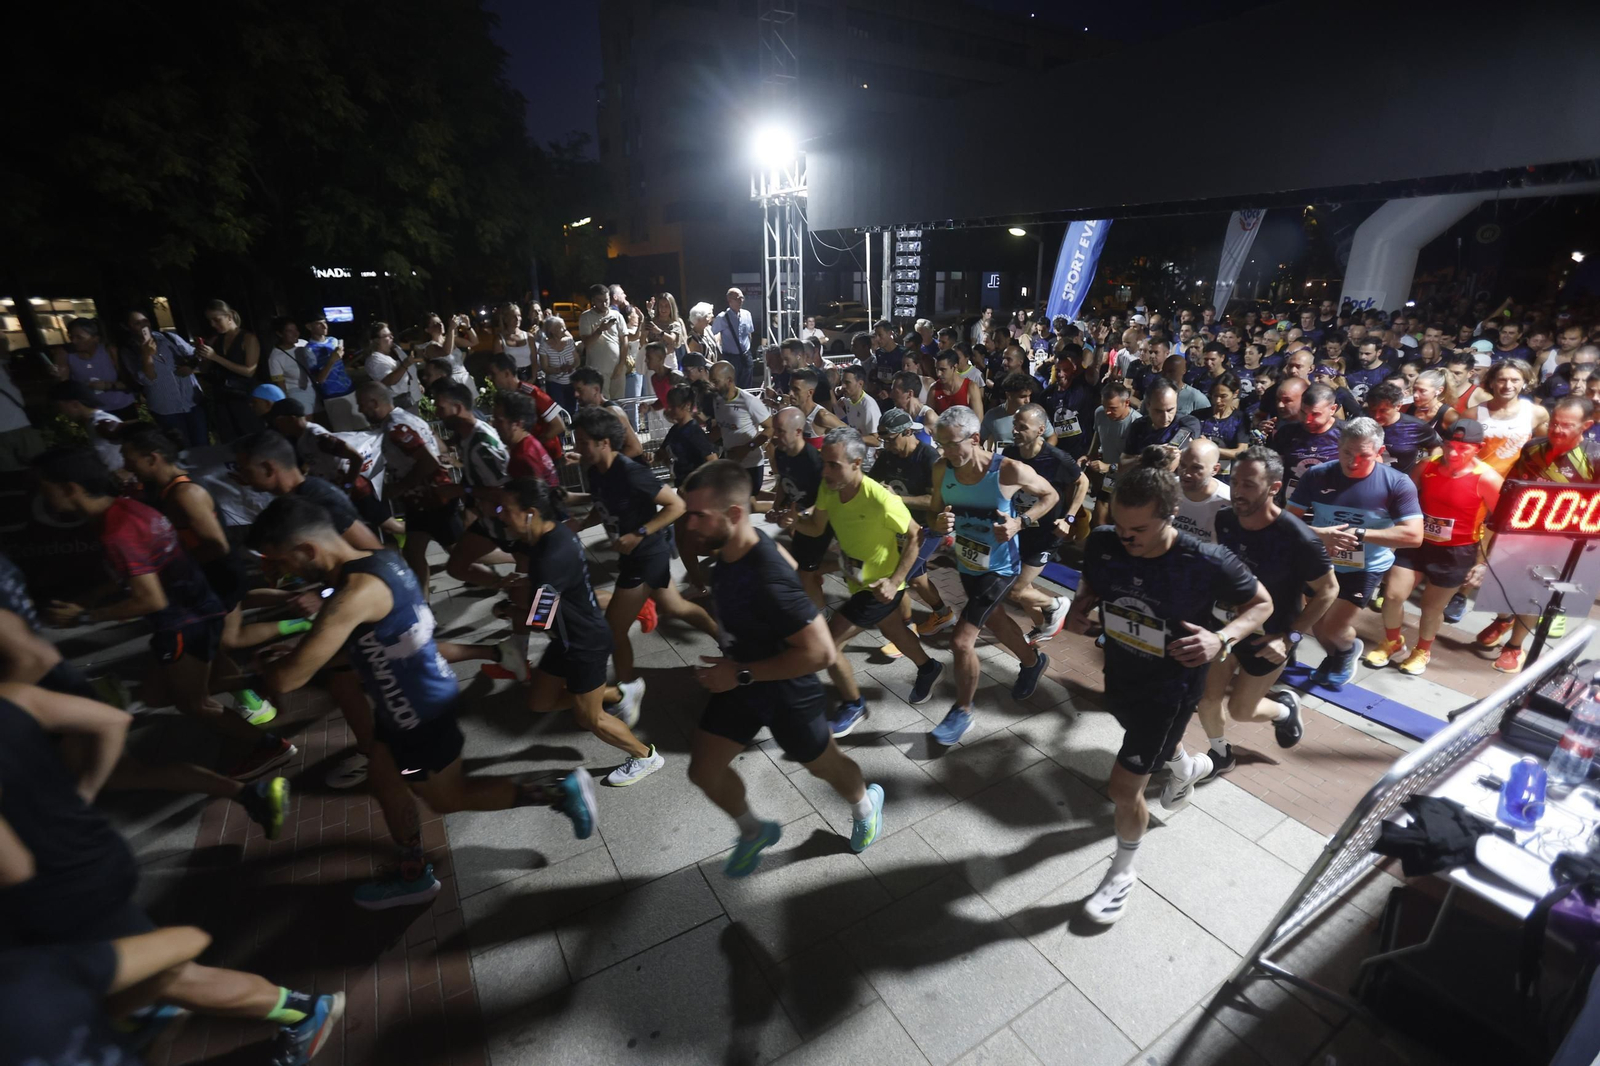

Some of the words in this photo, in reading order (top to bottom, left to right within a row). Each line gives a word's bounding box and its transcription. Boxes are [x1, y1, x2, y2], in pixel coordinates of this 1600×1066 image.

[1062, 250, 1085, 302] SPORT
[961, 546, 979, 562] 592
[1126, 620, 1140, 637] 11
[357, 630, 421, 731] NOCTURNA
